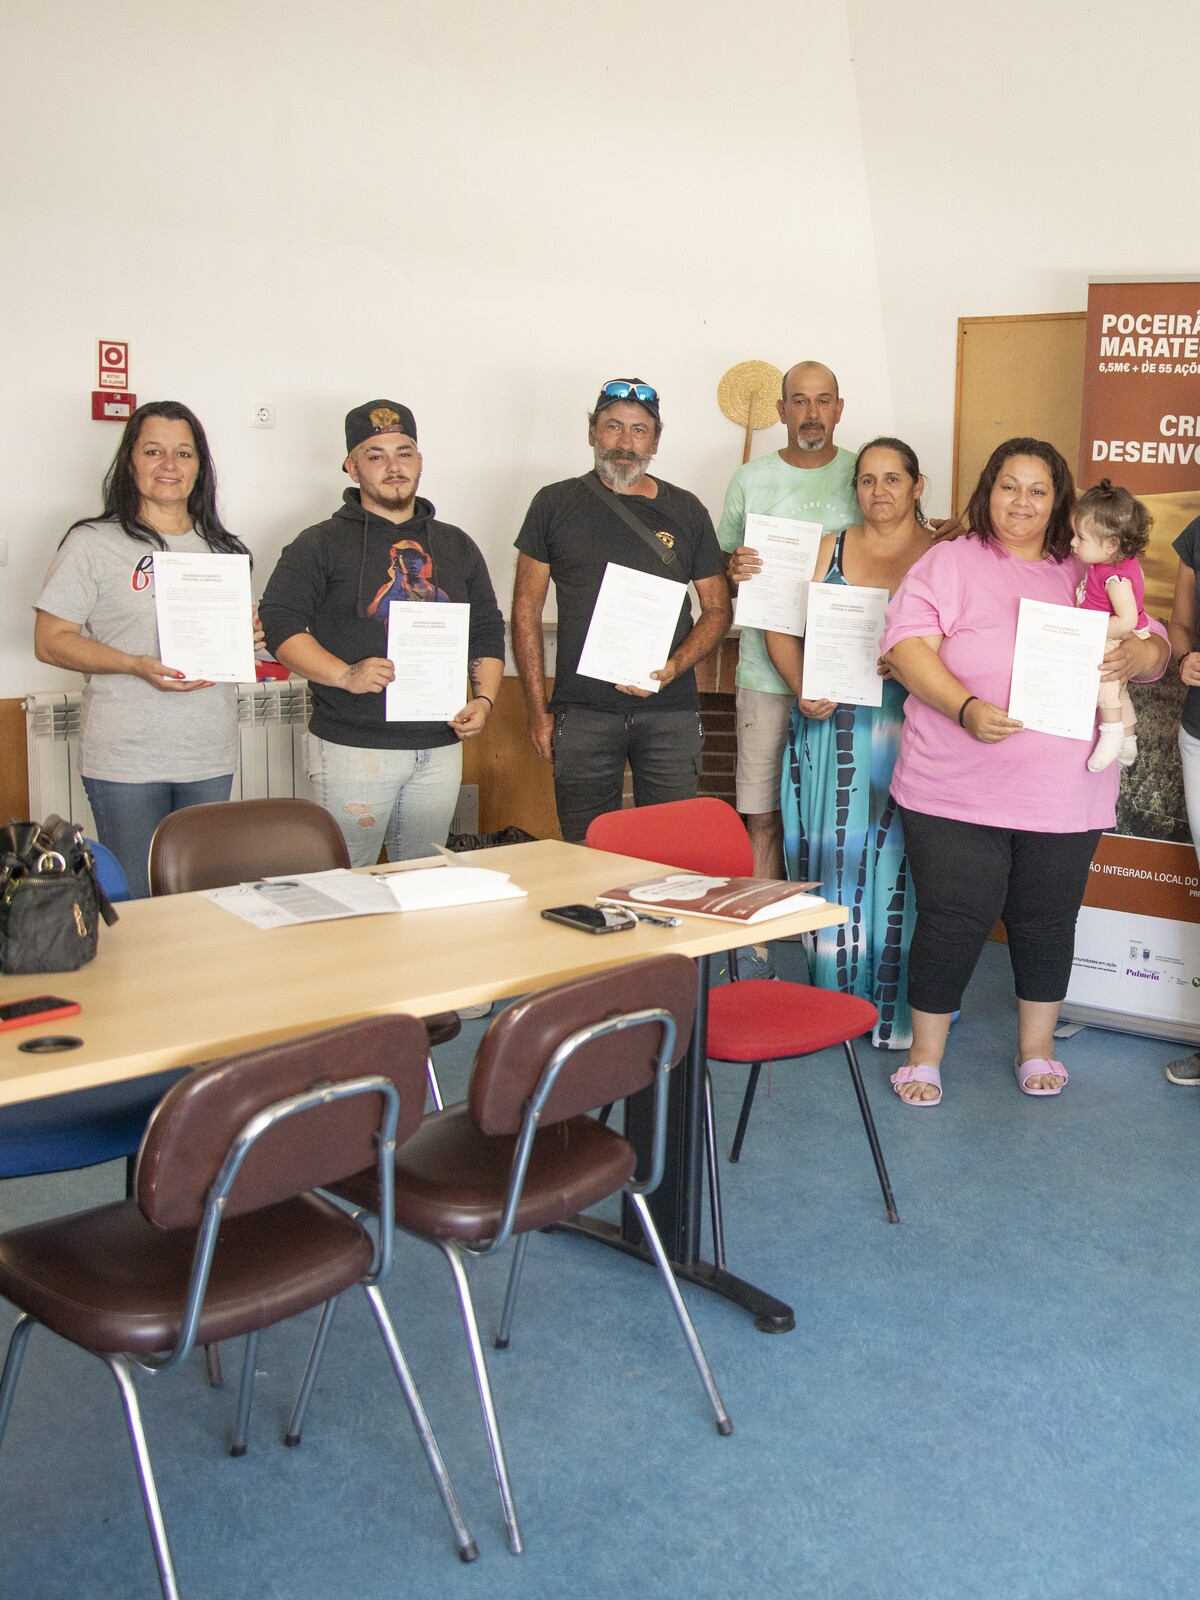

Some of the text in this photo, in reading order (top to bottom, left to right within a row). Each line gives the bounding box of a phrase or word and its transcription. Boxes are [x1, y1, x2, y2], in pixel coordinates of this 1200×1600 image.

[1098, 362, 1130, 374] 6,5M€
[1141, 361, 1156, 373] DE
[1158, 363, 1172, 373] 55
[1103, 864, 1153, 881] INTEGRADA
[1154, 872, 1183, 885] LOCAL
[1184, 876, 1199, 887] DO
[1125, 968, 1160, 981] Palmela
